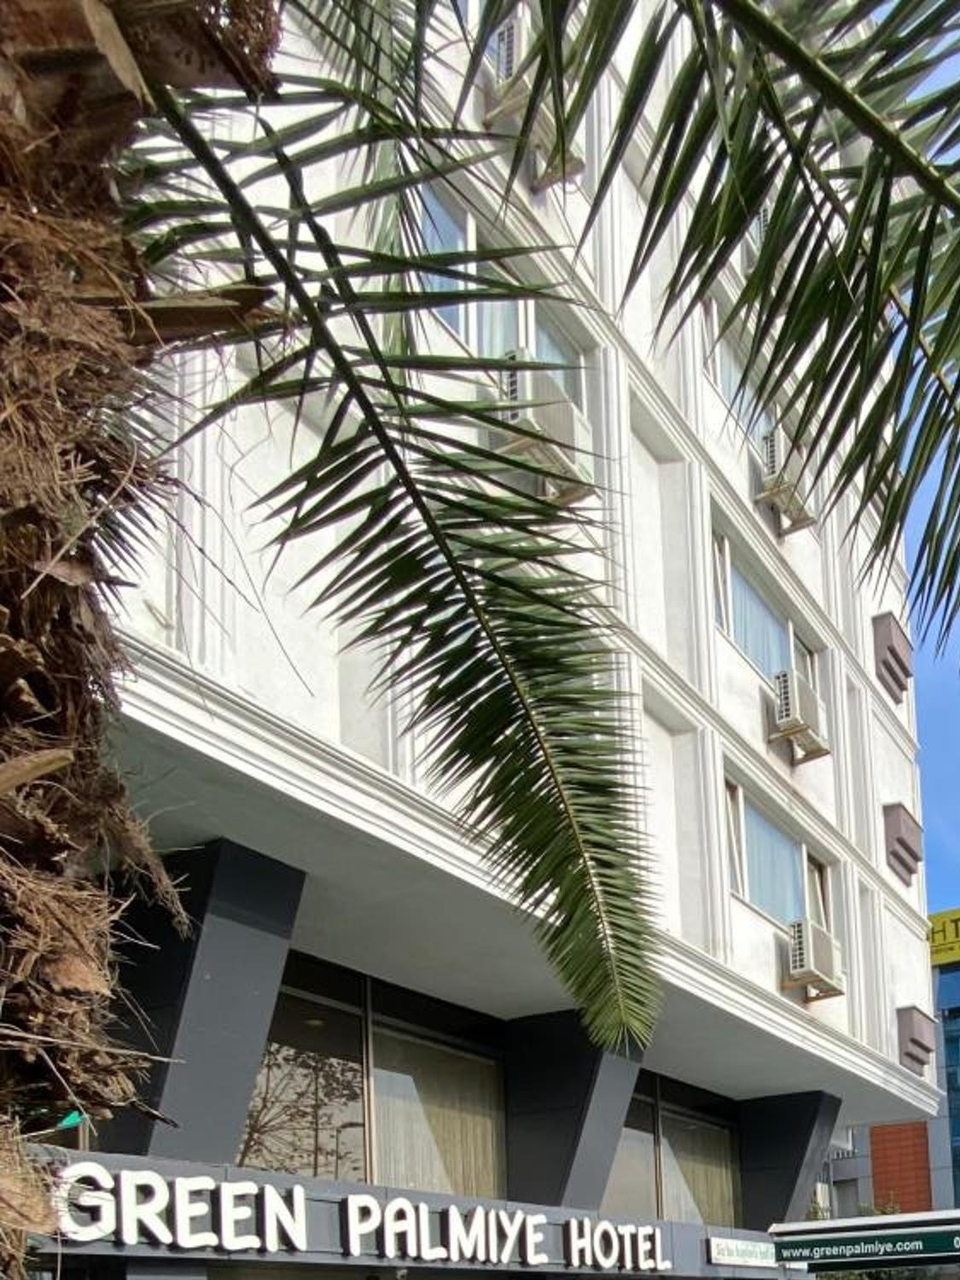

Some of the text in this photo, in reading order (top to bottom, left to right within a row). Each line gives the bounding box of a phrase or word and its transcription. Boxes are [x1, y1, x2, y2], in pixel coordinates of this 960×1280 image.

[53, 1161, 672, 1271] GREEN PALMIYE HOTEL
[781, 1239, 923, 1260] www.greenpalmiye.com
